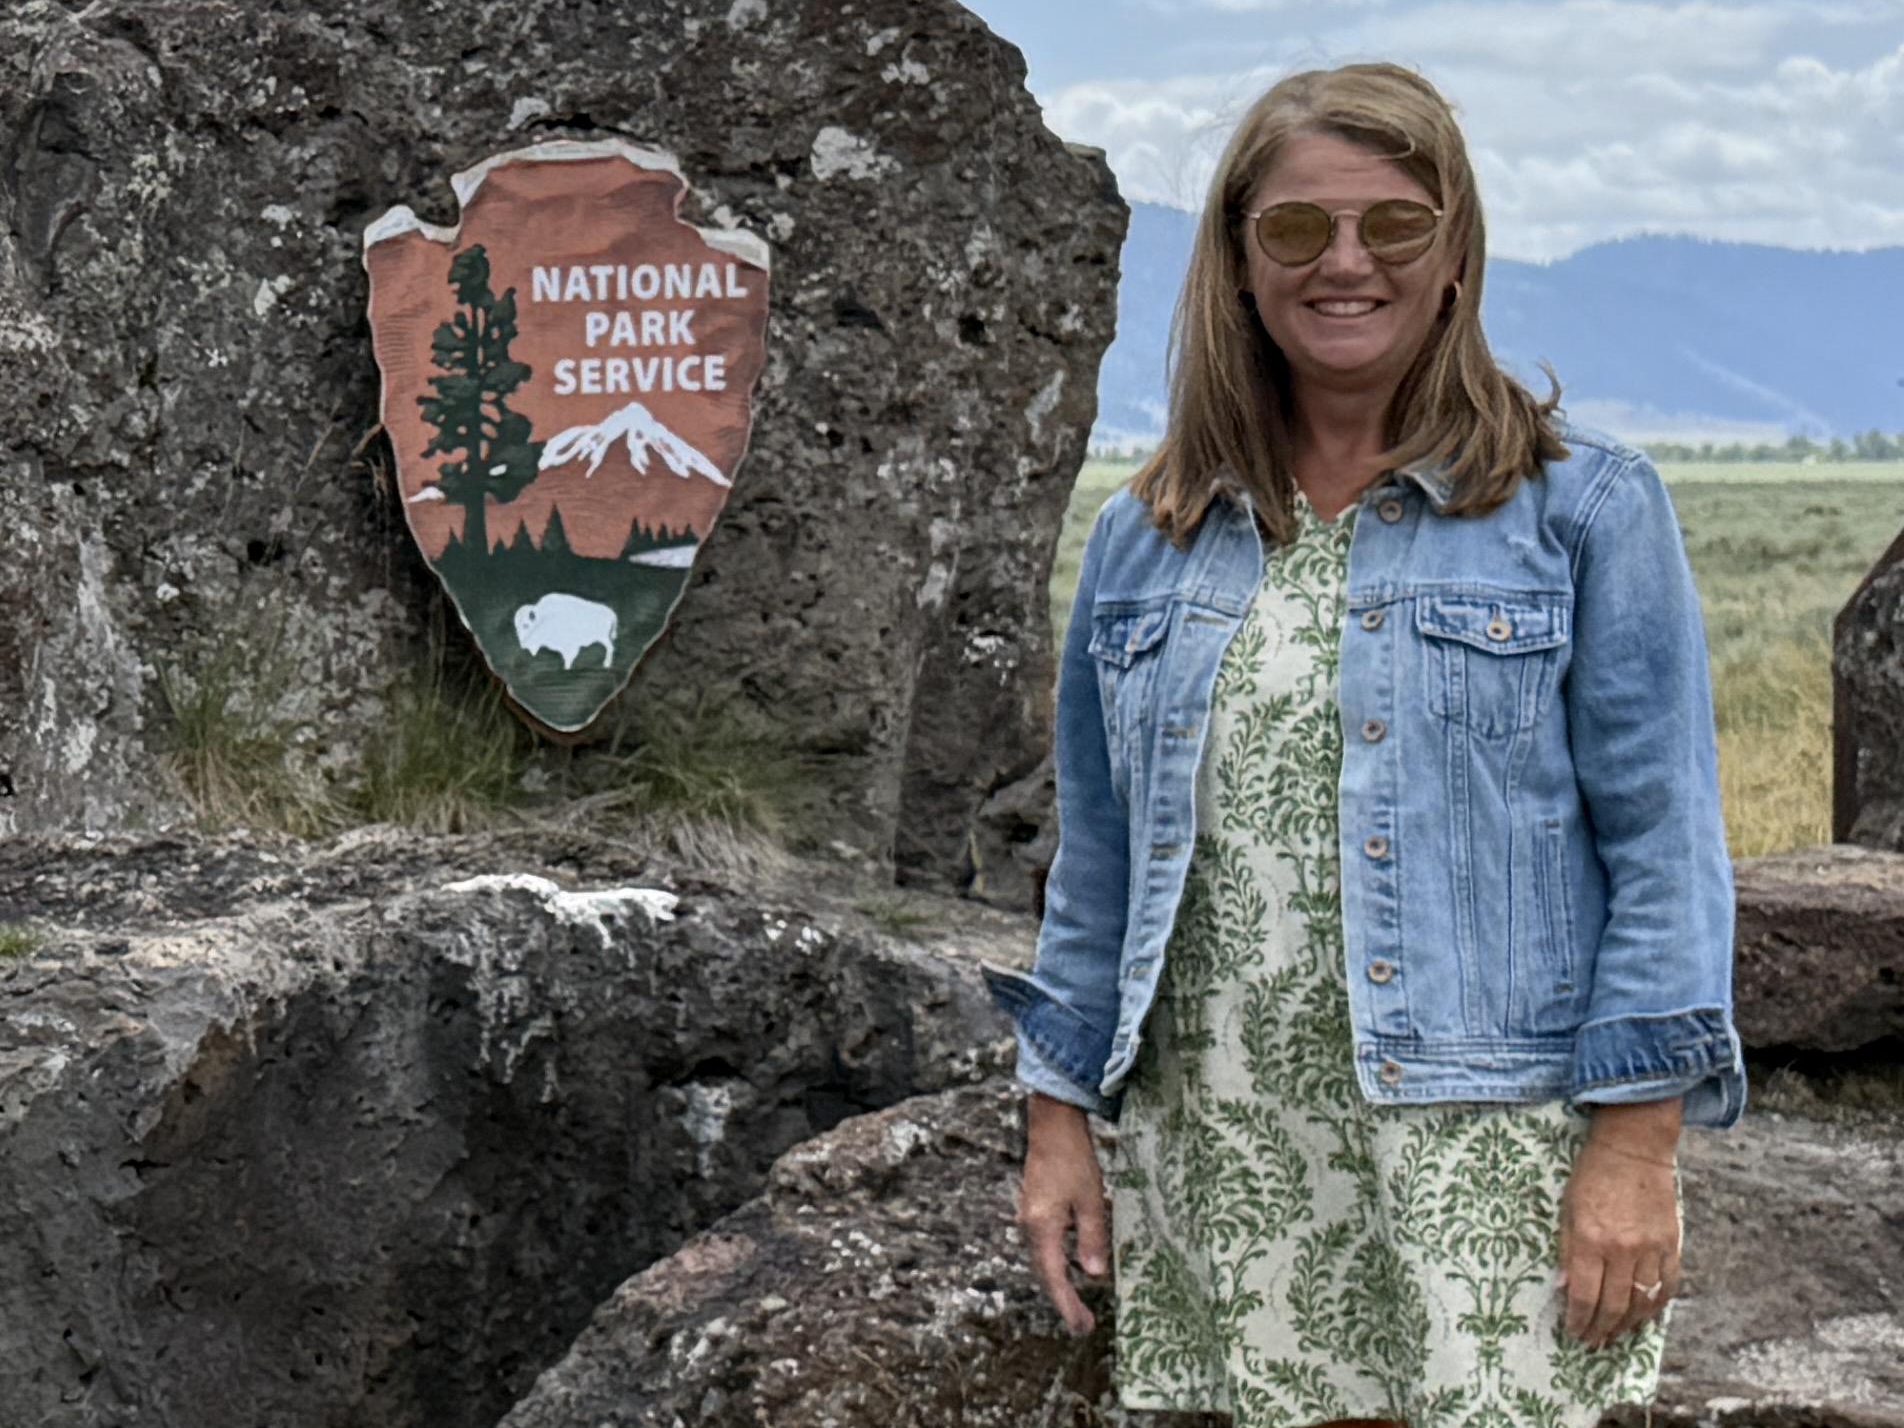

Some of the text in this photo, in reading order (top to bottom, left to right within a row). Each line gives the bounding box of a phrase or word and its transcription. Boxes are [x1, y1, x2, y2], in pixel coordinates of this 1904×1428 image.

[531, 262, 748, 302] NATIONAL
[584, 309, 697, 348] PARK
[553, 355, 728, 396] SERVICE
